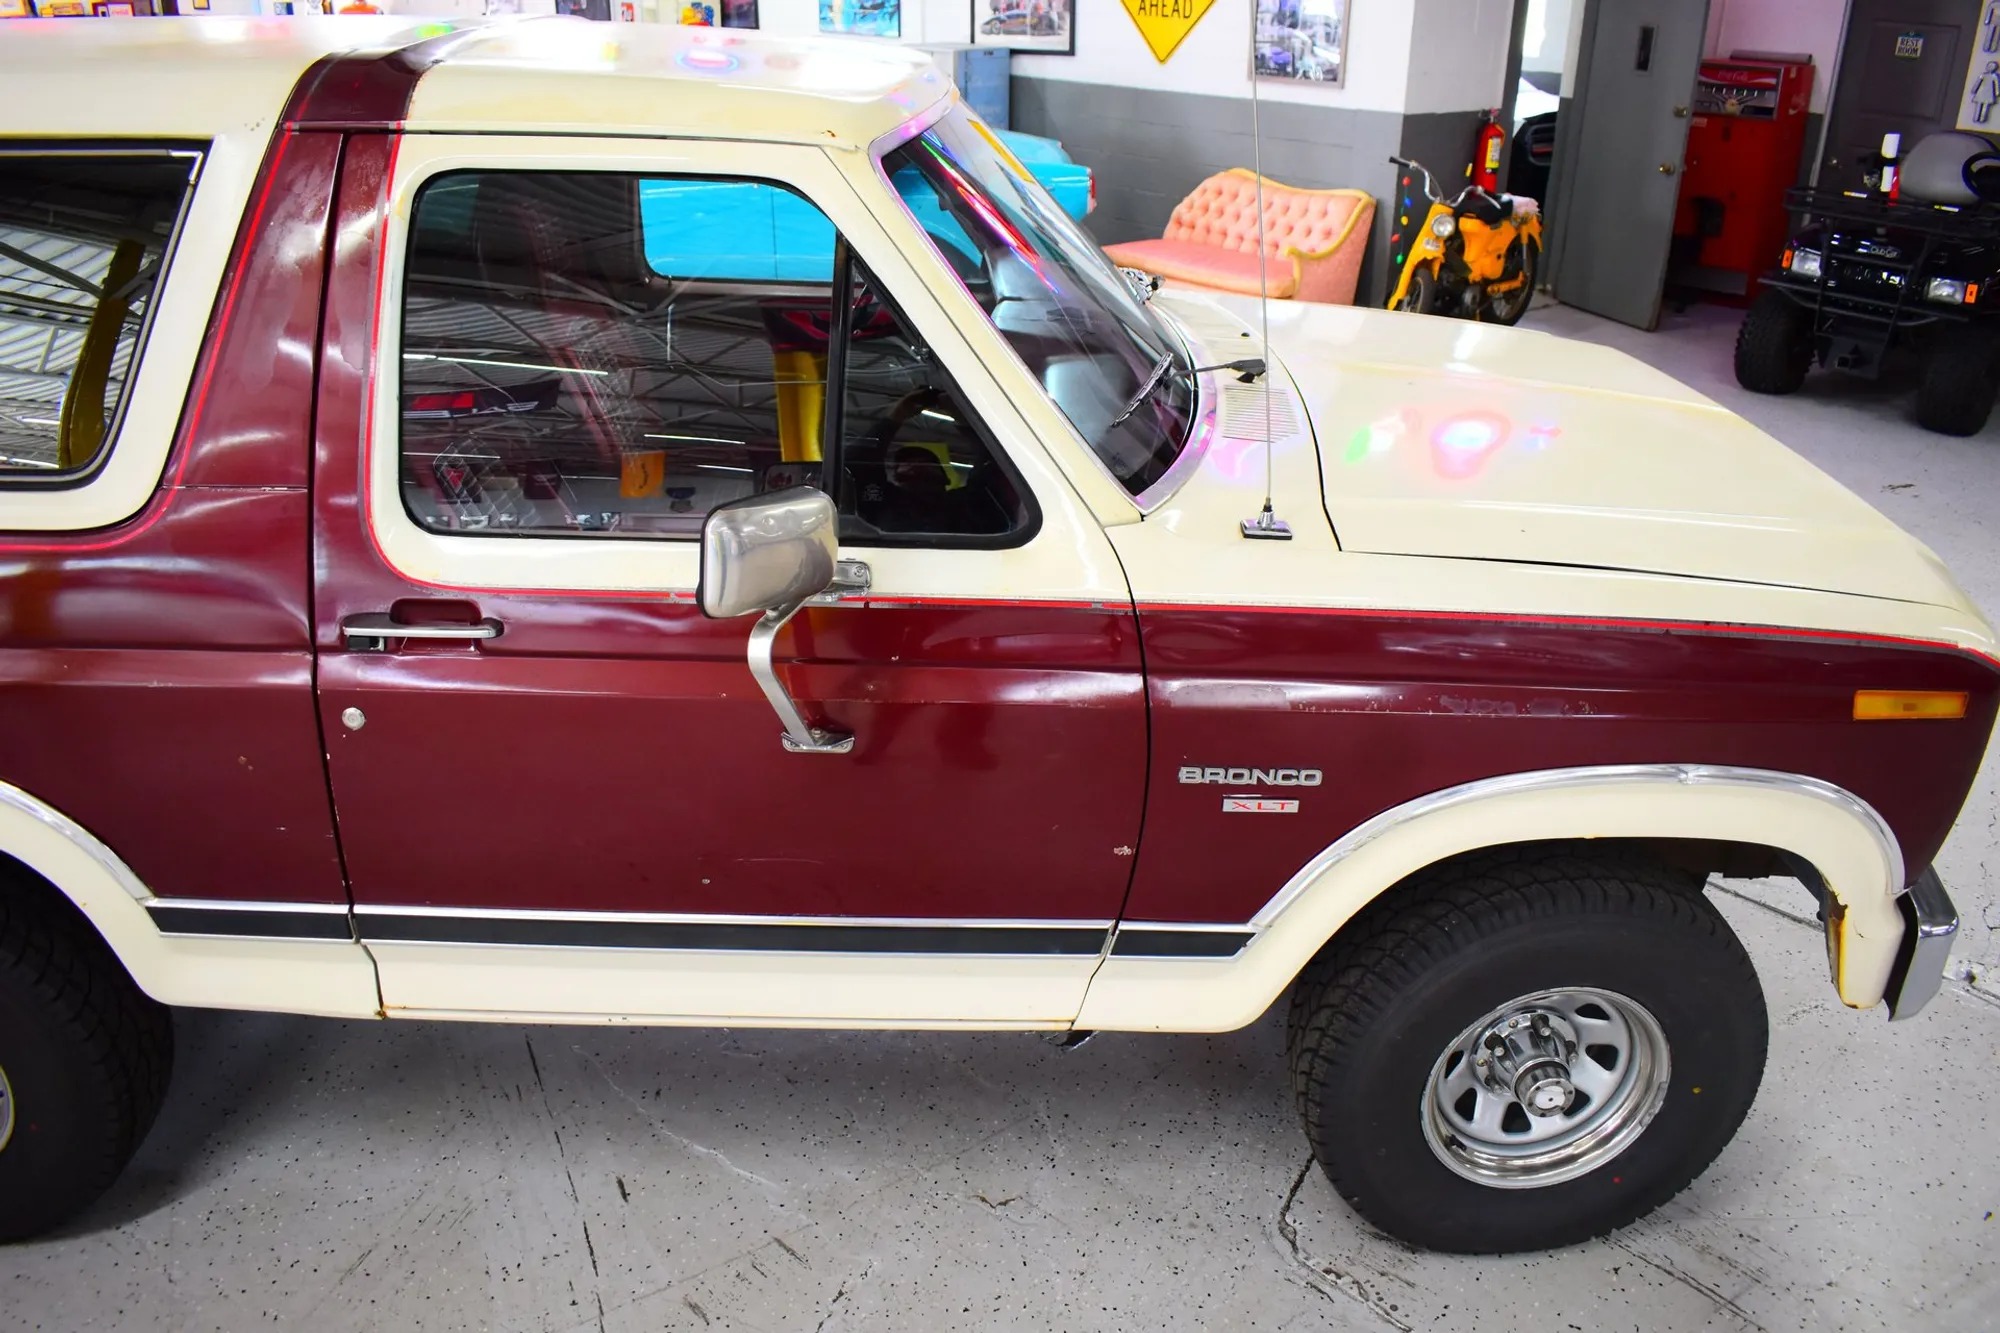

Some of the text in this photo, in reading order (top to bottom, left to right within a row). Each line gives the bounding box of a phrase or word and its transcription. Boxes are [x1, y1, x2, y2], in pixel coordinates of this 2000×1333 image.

[1138, 0, 1192, 18] AHEAD
[1900, 37, 1919, 47] REST
[1897, 46, 1919, 56] ROOM
[1178, 766, 1323, 786] BRONCO
[1232, 801, 1294, 811] XLT
